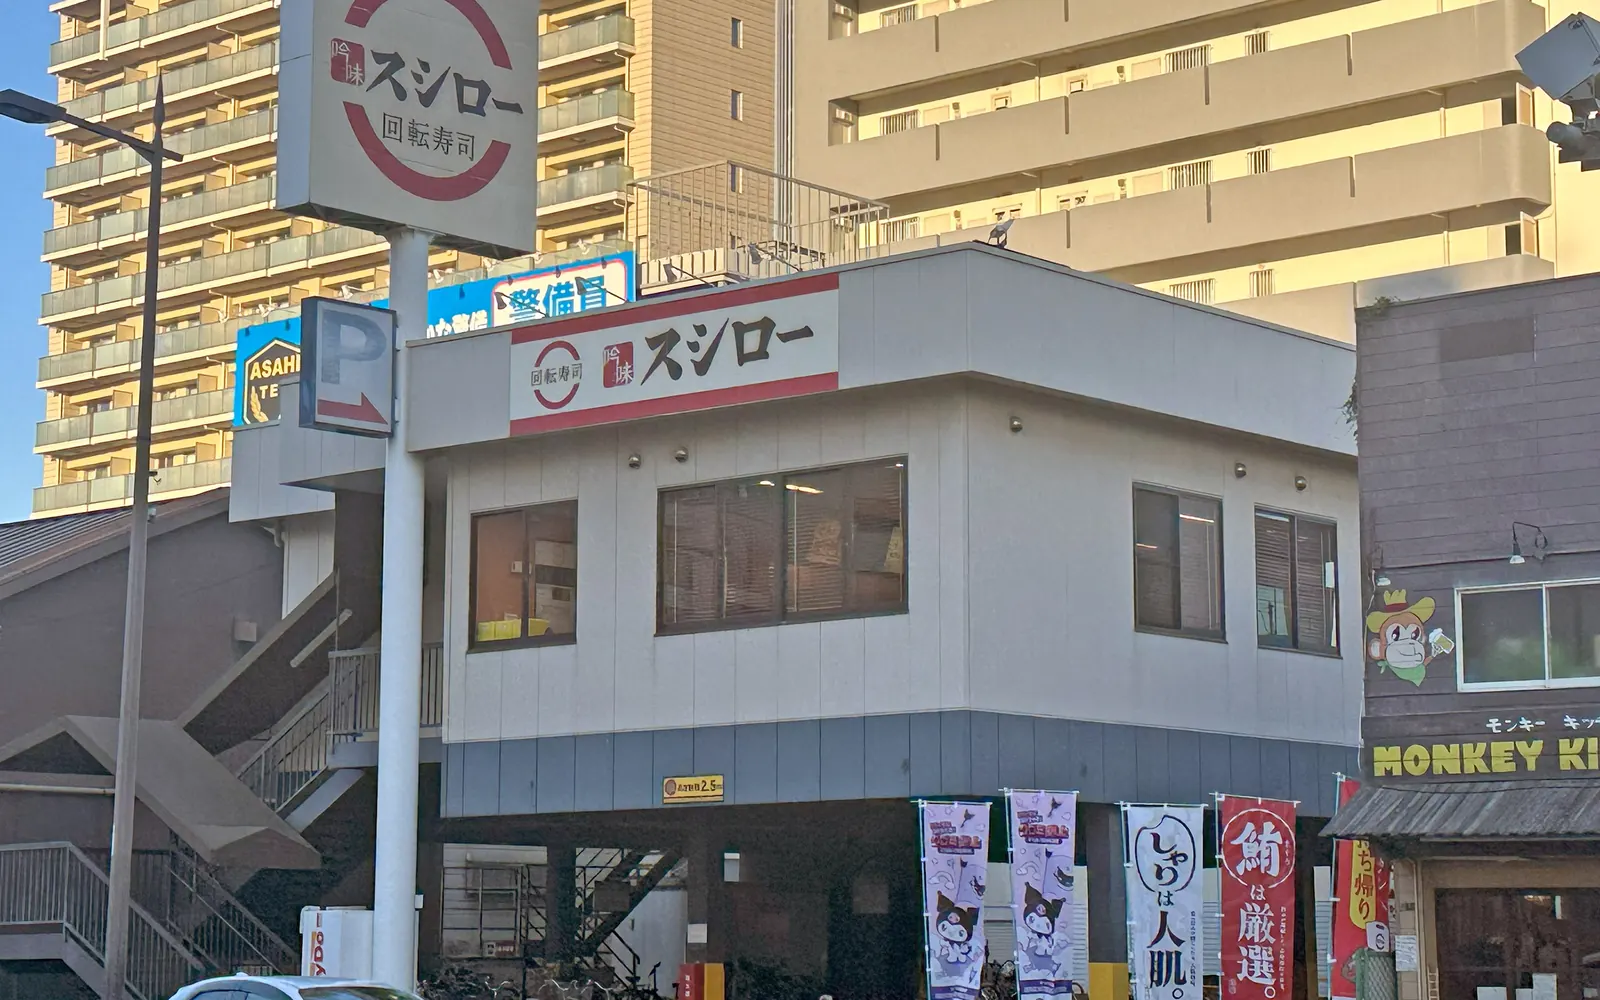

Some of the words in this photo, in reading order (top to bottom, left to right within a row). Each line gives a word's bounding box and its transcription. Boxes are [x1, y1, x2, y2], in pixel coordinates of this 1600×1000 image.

[331, 39, 365, 85] 吟味
[365, 49, 524, 117] スシロー
[382, 112, 475, 161] 回転寿司
[250, 353, 301, 381] ASAHI
[321, 309, 387, 385] P
[603, 346, 634, 385] 吟味
[641, 316, 814, 386] スシロー
[530, 362, 583, 387] 回転寿司
[1486, 716, 1546, 733] モンキー
[1373, 739, 1544, 777] MONKEY
[1558, 737, 1599, 771] KI
